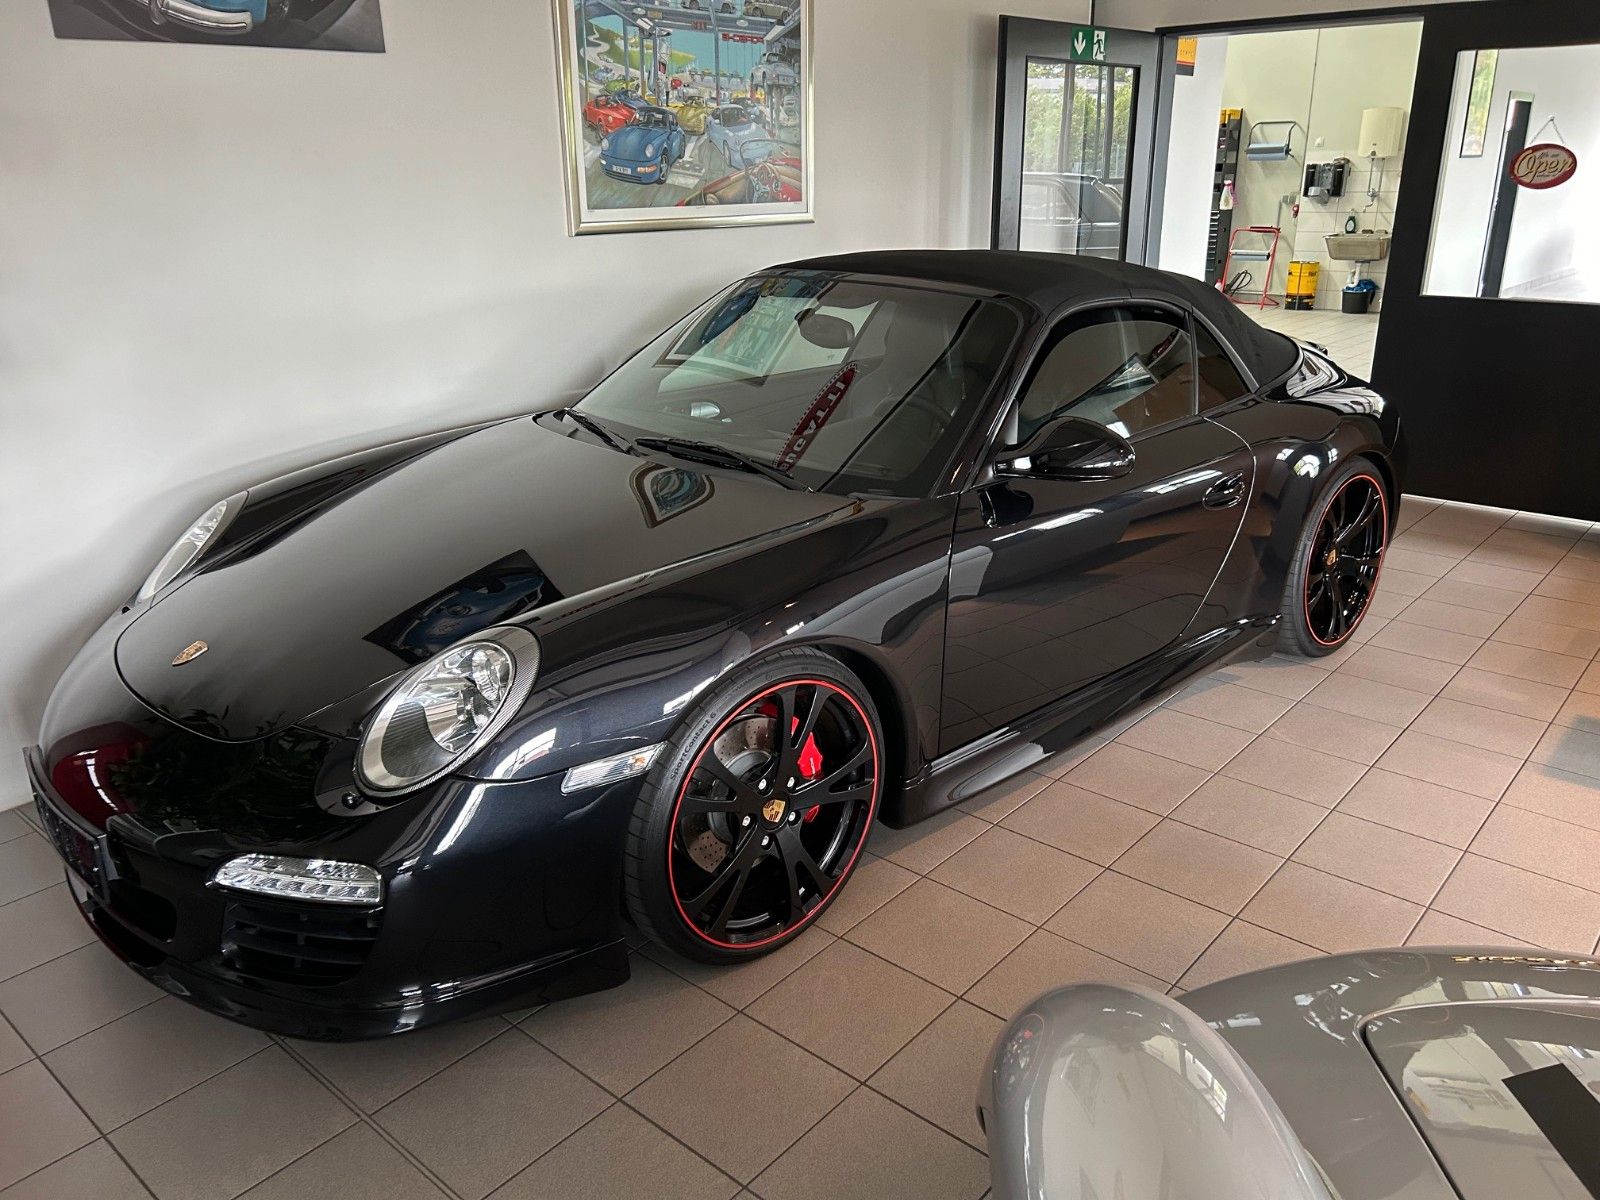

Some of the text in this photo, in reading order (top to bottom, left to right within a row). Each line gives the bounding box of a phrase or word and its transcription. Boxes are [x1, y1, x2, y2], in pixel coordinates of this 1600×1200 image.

[1515, 150, 1574, 184] Open
[670, 711, 717, 779] SportContact 6
